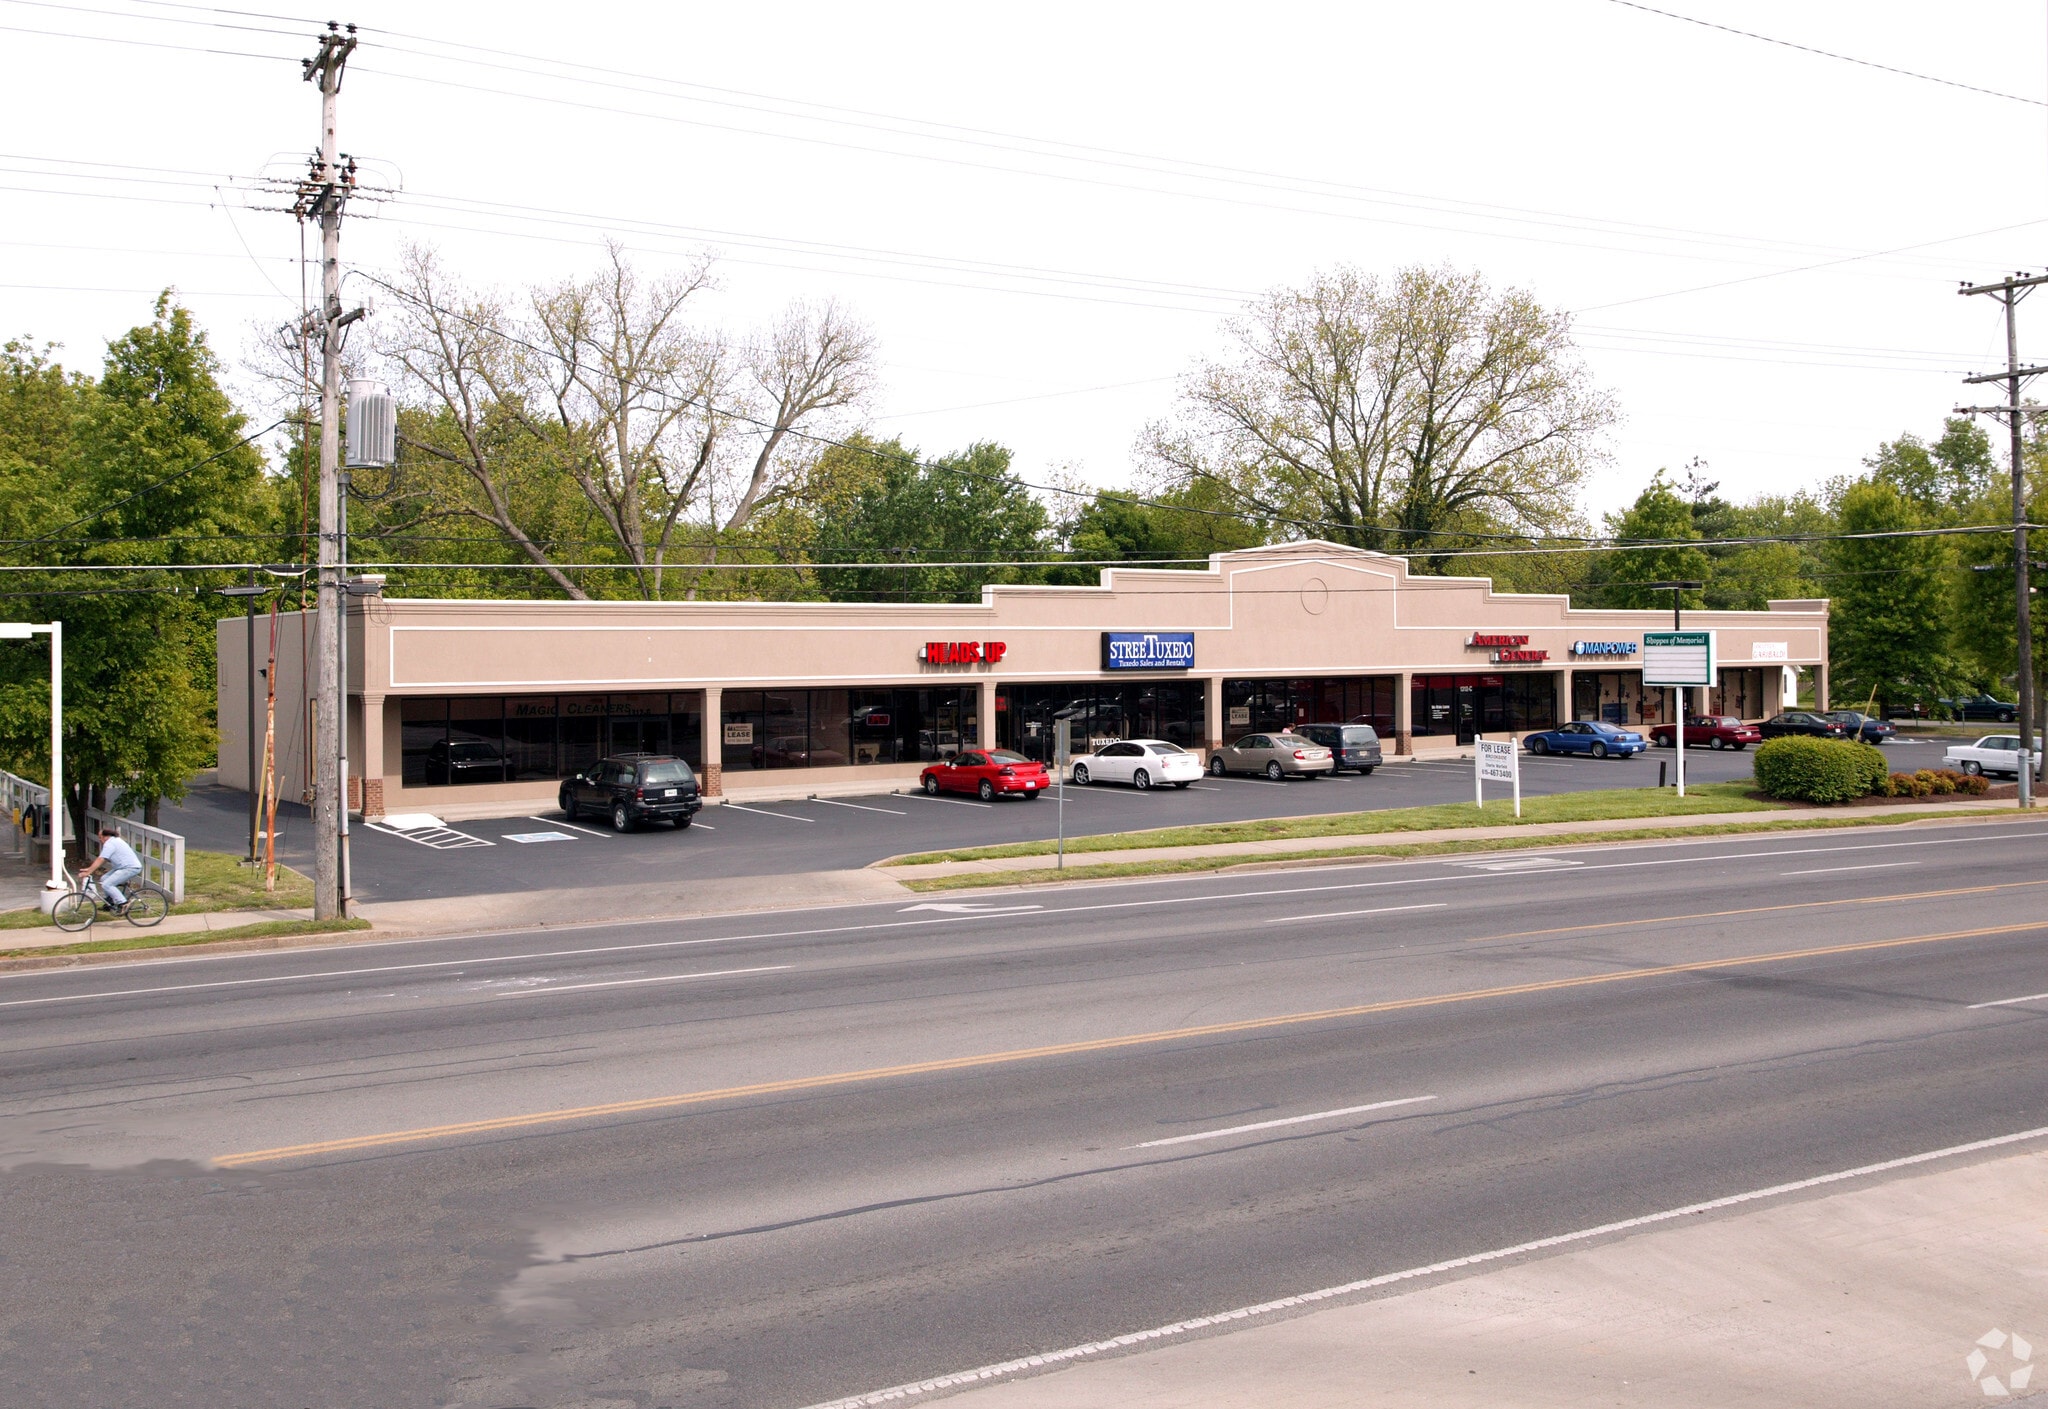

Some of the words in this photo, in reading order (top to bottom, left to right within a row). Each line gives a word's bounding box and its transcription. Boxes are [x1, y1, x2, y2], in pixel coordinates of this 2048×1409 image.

[1472, 632, 1529, 646] AMERICAN
[1646, 636, 1669, 645] Shoppes
[1676, 636, 1705, 644] Memorial
[926, 641, 980, 663] HEADS
[983, 641, 1007, 663] UP
[1499, 647, 1550, 661] GENERAL
[1585, 641, 1637, 655] MANPOWER
[1139, 659, 1154, 667] Sales
[1481, 744, 1491, 752] FOR
[1494, 745, 1511, 754] LEASE
